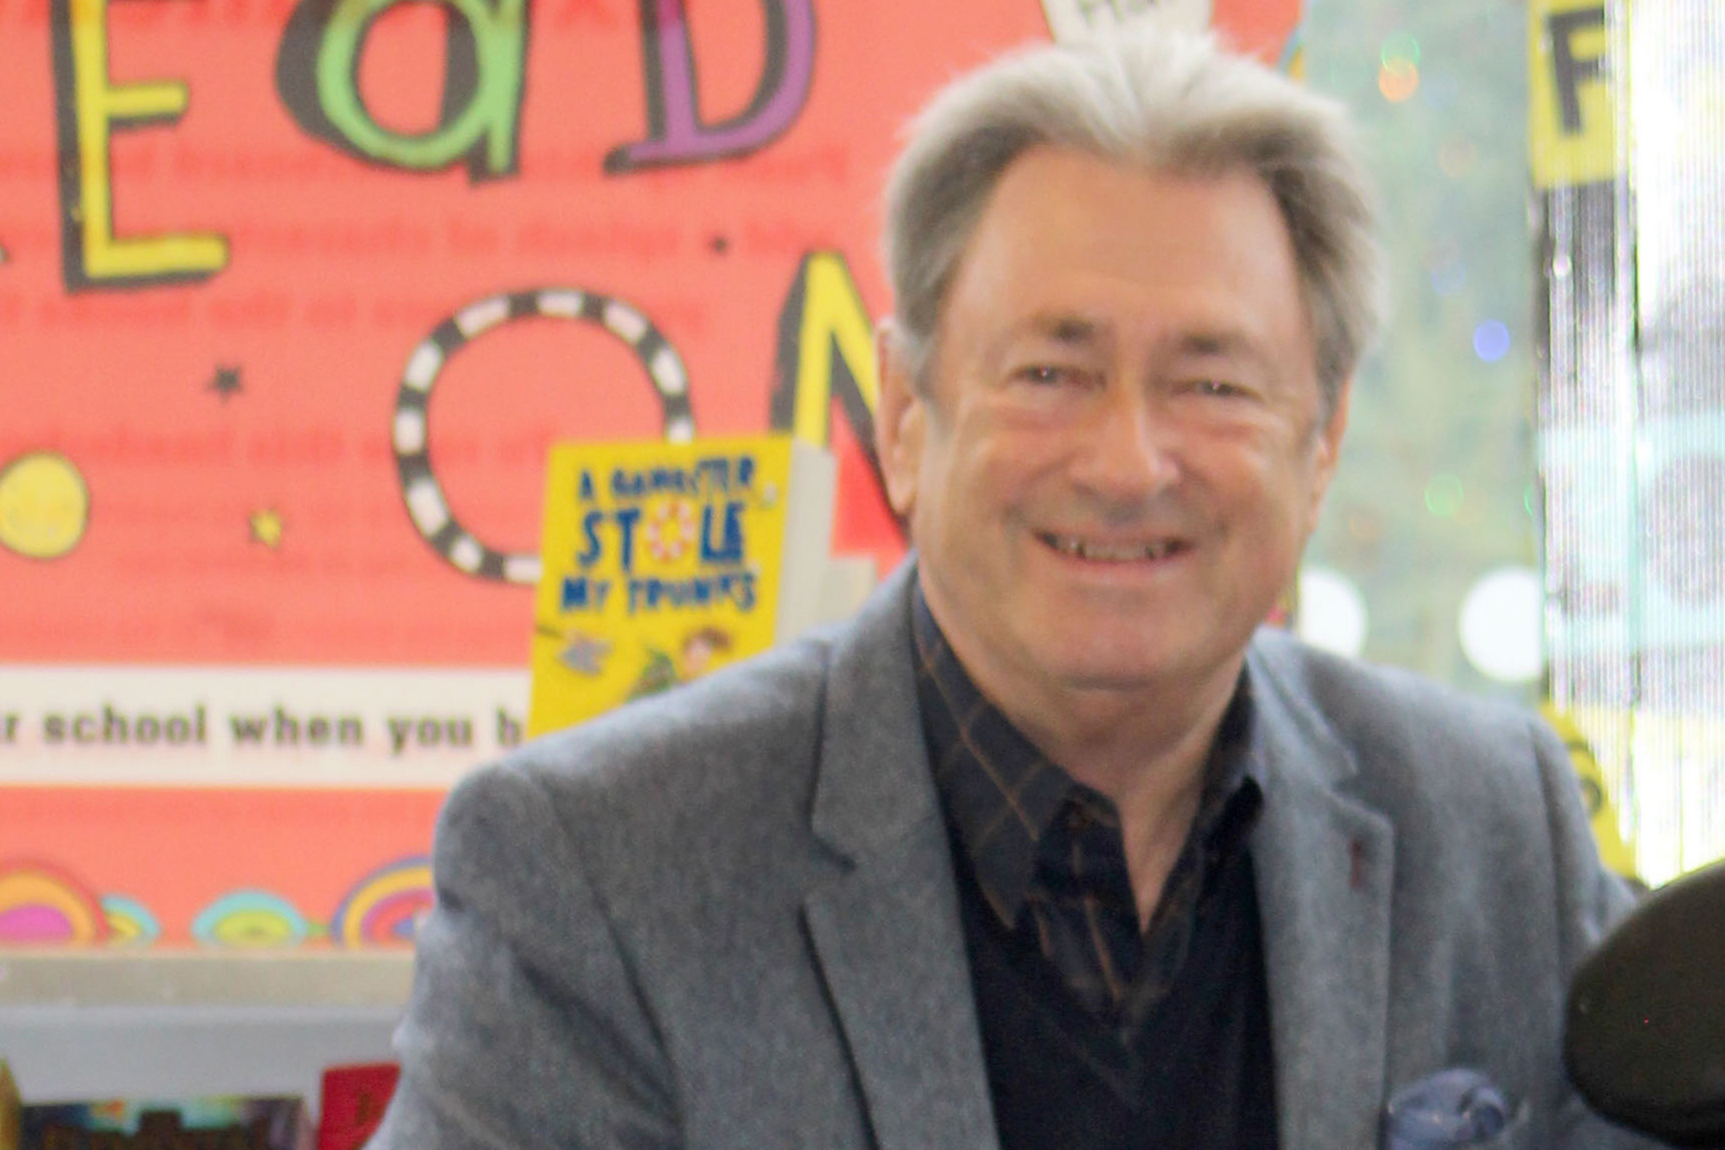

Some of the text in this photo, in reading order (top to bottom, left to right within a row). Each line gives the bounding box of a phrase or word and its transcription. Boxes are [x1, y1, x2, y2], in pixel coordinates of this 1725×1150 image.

[576, 501, 744, 571] STOLE
[43, 704, 207, 746] school
[228, 704, 365, 746] when
[387, 712, 474, 753] you
